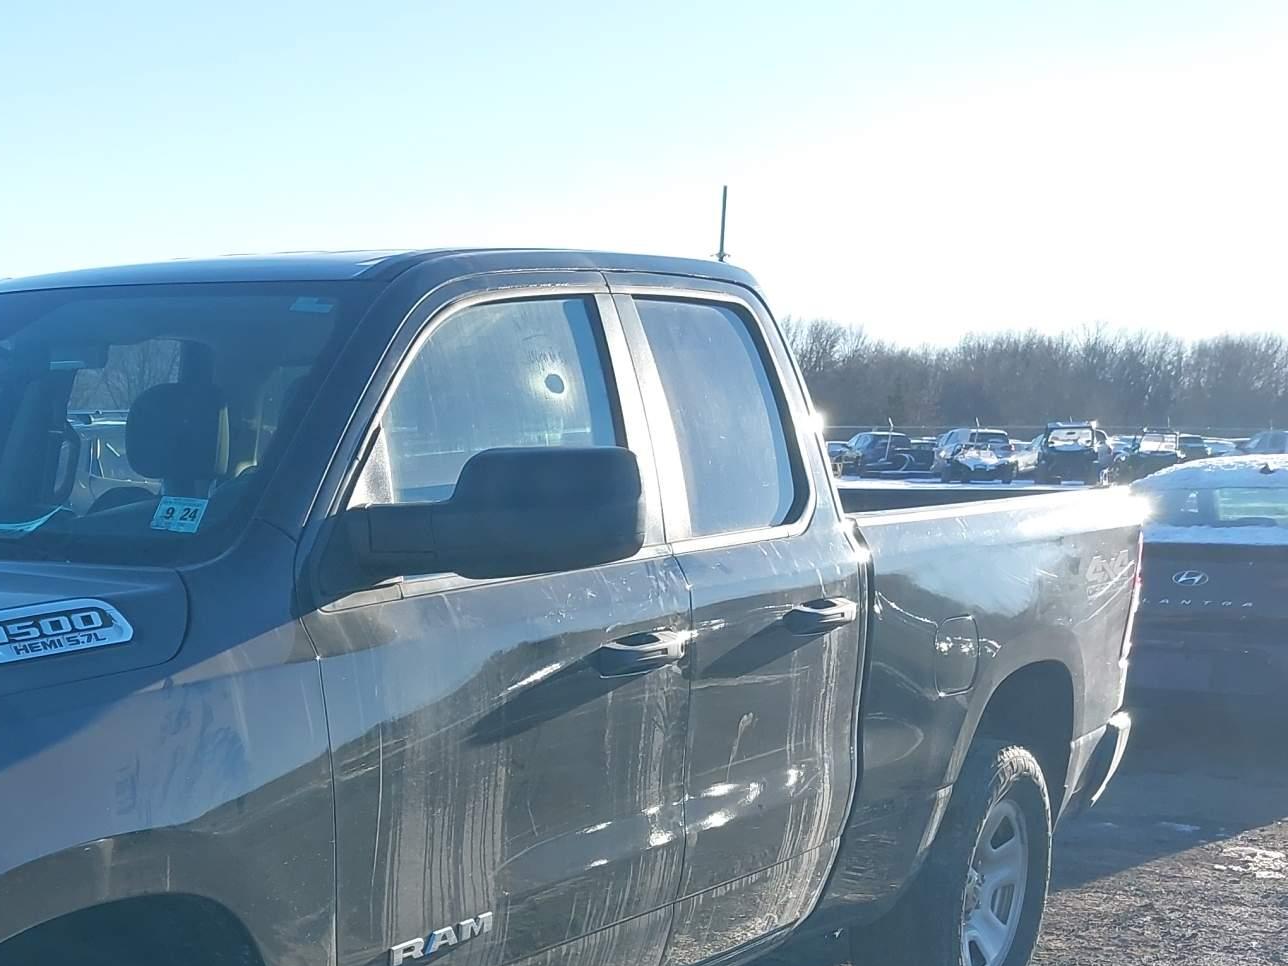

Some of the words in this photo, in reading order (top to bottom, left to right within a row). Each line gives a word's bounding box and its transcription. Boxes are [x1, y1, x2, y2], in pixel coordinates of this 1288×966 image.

[164, 506, 176, 519] 9
[179, 507, 200, 521] 24
[13, 638, 64, 655] HEMI
[67, 631, 106, 647] 5.7L
